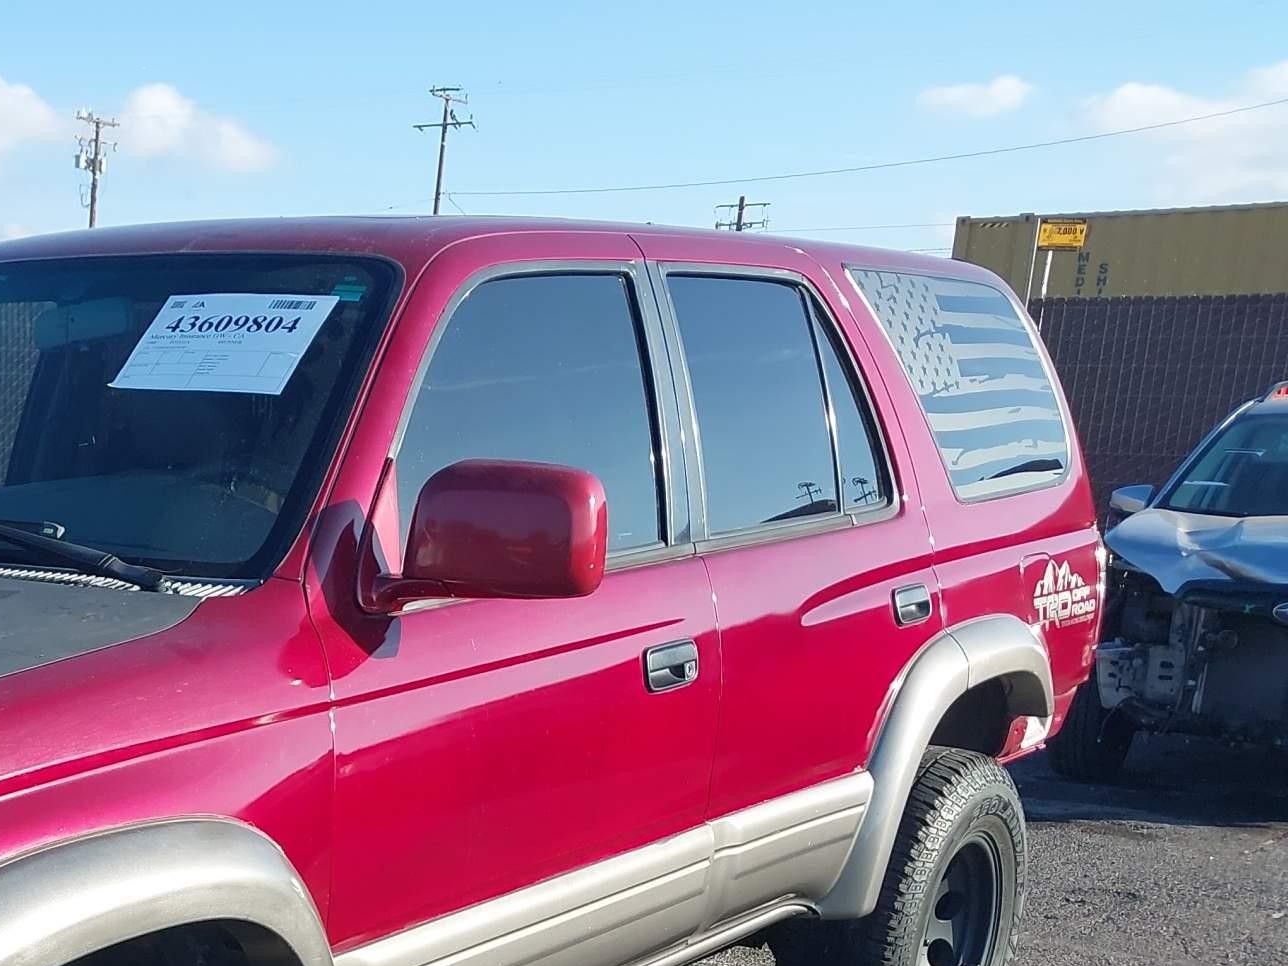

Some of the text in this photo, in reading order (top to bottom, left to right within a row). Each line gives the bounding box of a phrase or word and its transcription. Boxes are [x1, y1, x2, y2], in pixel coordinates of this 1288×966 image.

[166, 315, 302, 334] 43609804
[1033, 590, 1071, 621] TRD
[1071, 598, 1097, 617] ROAD
